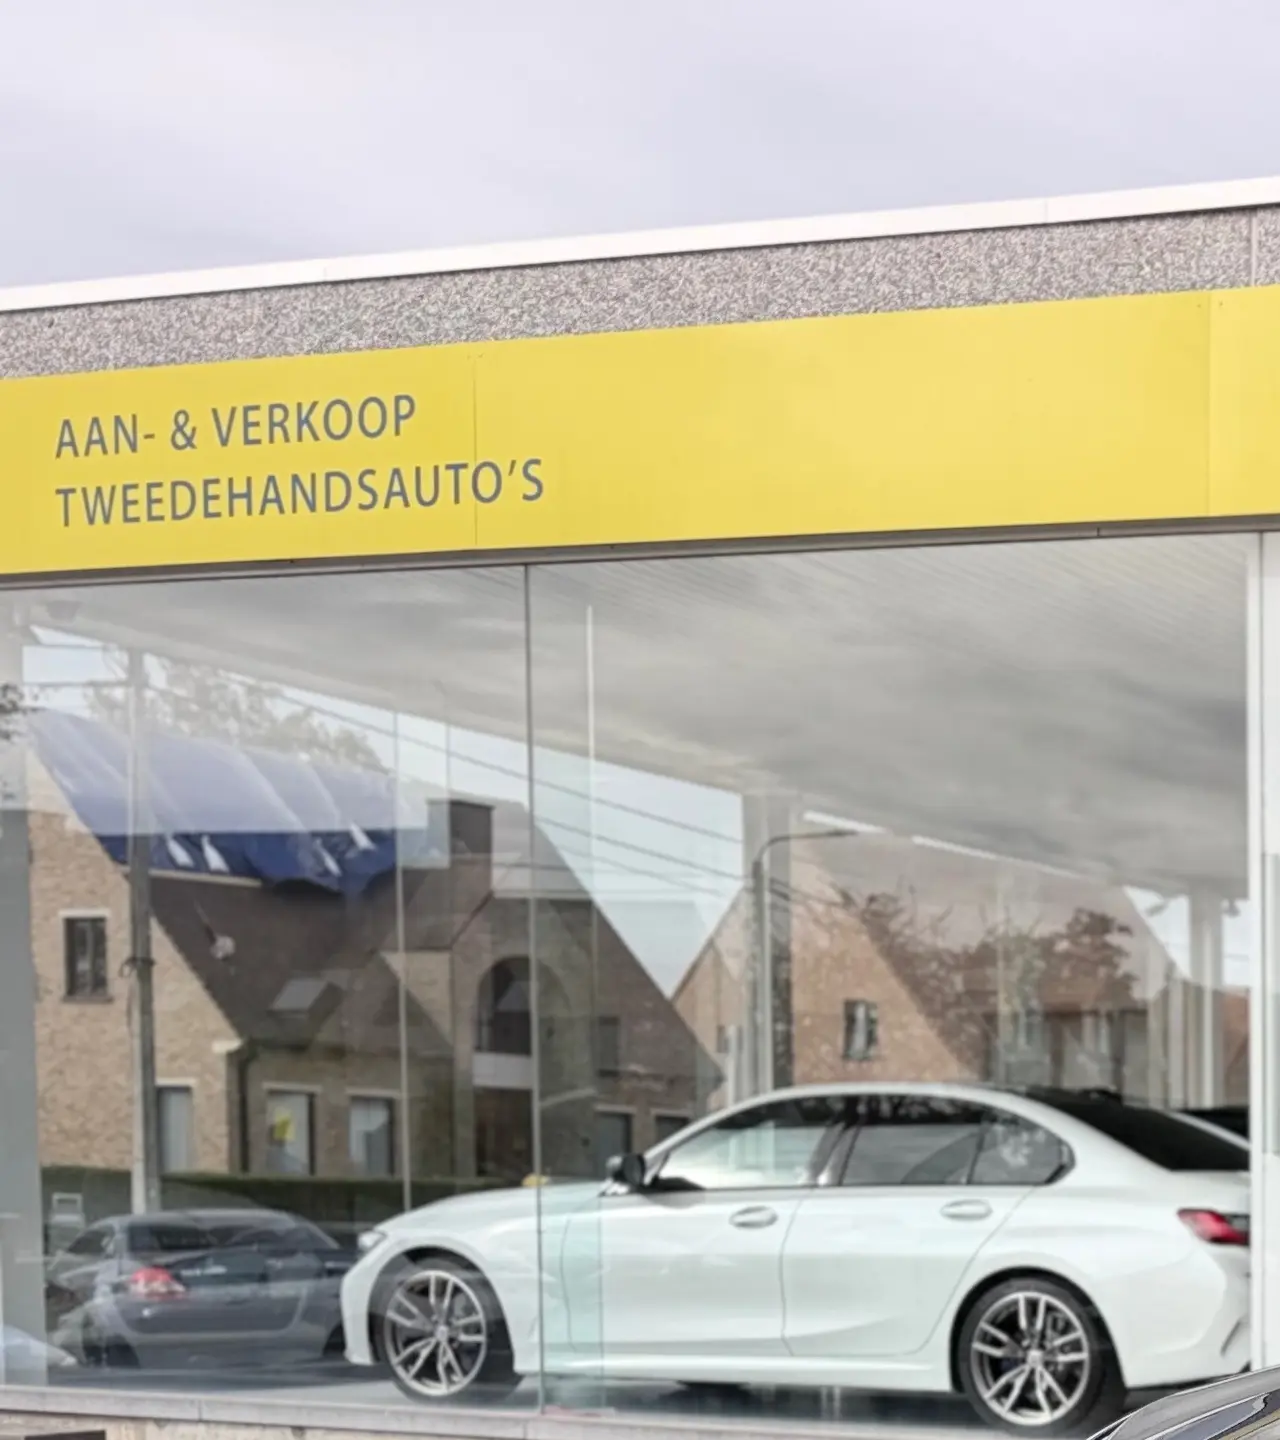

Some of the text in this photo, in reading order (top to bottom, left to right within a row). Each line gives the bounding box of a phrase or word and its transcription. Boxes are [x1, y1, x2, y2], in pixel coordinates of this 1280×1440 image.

[56, 394, 417, 458] AAN- & VERKOOP
[55, 458, 545, 527] TWEEDEHANDSAUTO'S
